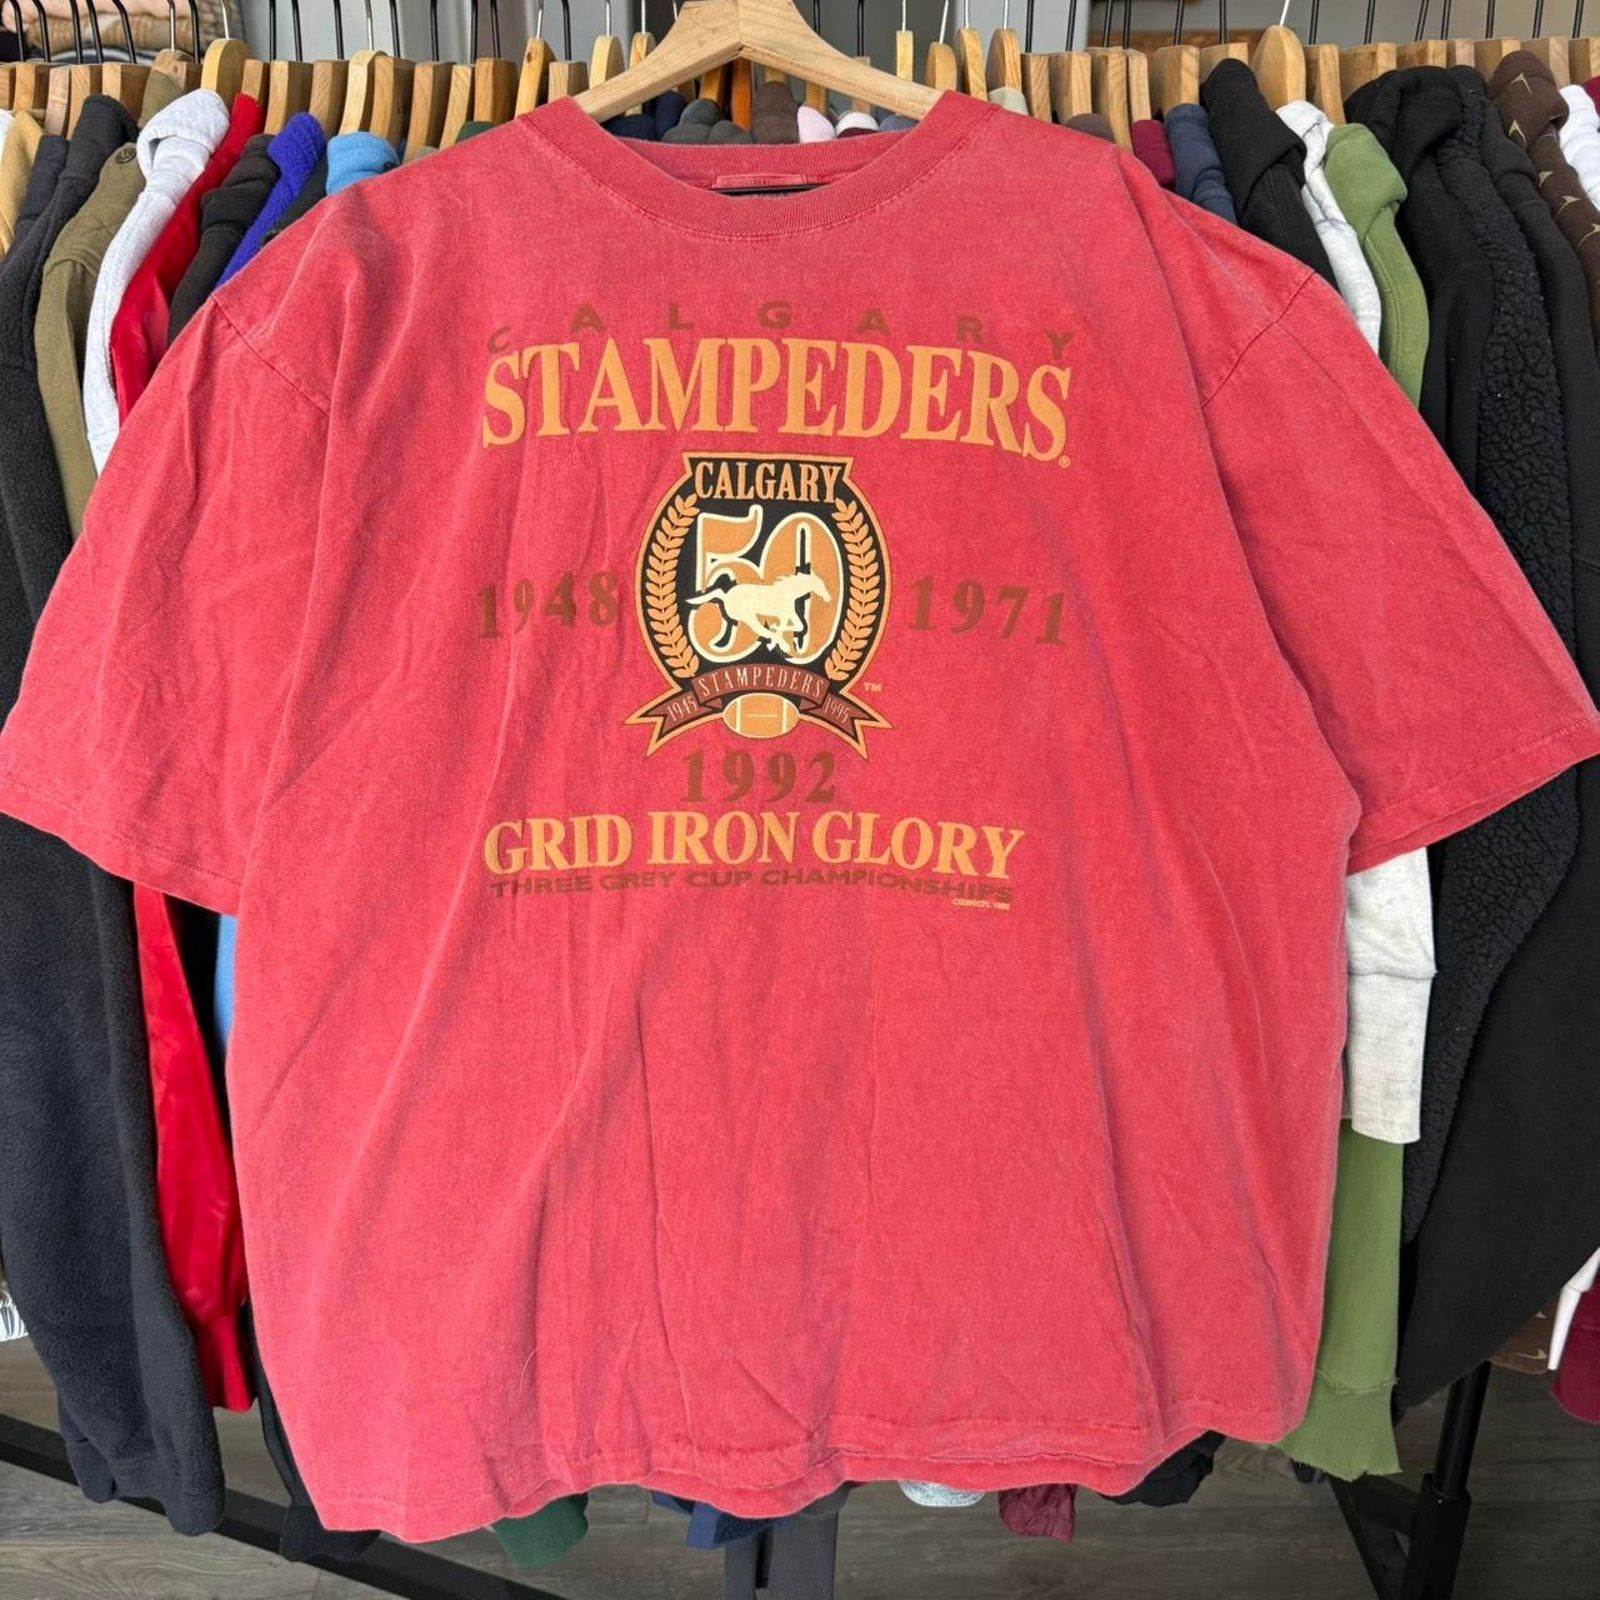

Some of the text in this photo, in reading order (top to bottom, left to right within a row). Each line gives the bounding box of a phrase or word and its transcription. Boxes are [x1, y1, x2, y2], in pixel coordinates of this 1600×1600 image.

[487, 300, 1076, 360] CALGARY
[481, 336, 1071, 462] STAMPEDERS
[694, 460, 842, 504] CALGARY
[477, 569, 619, 641] 1948
[687, 504, 845, 665] 50
[909, 574, 1066, 646] 1971
[666, 694, 698, 722] 1945
[698, 665, 825, 698] STAMPEDERS
[682, 750, 837, 804] 1992
[484, 810, 1026, 880] GRID IRON GLORY
[491, 874, 593, 898] THREE
[599, 870, 676, 893] GREY
[684, 869, 752, 890] CUP
[760, 868, 1014, 906] CHAMPIONSHIPS
